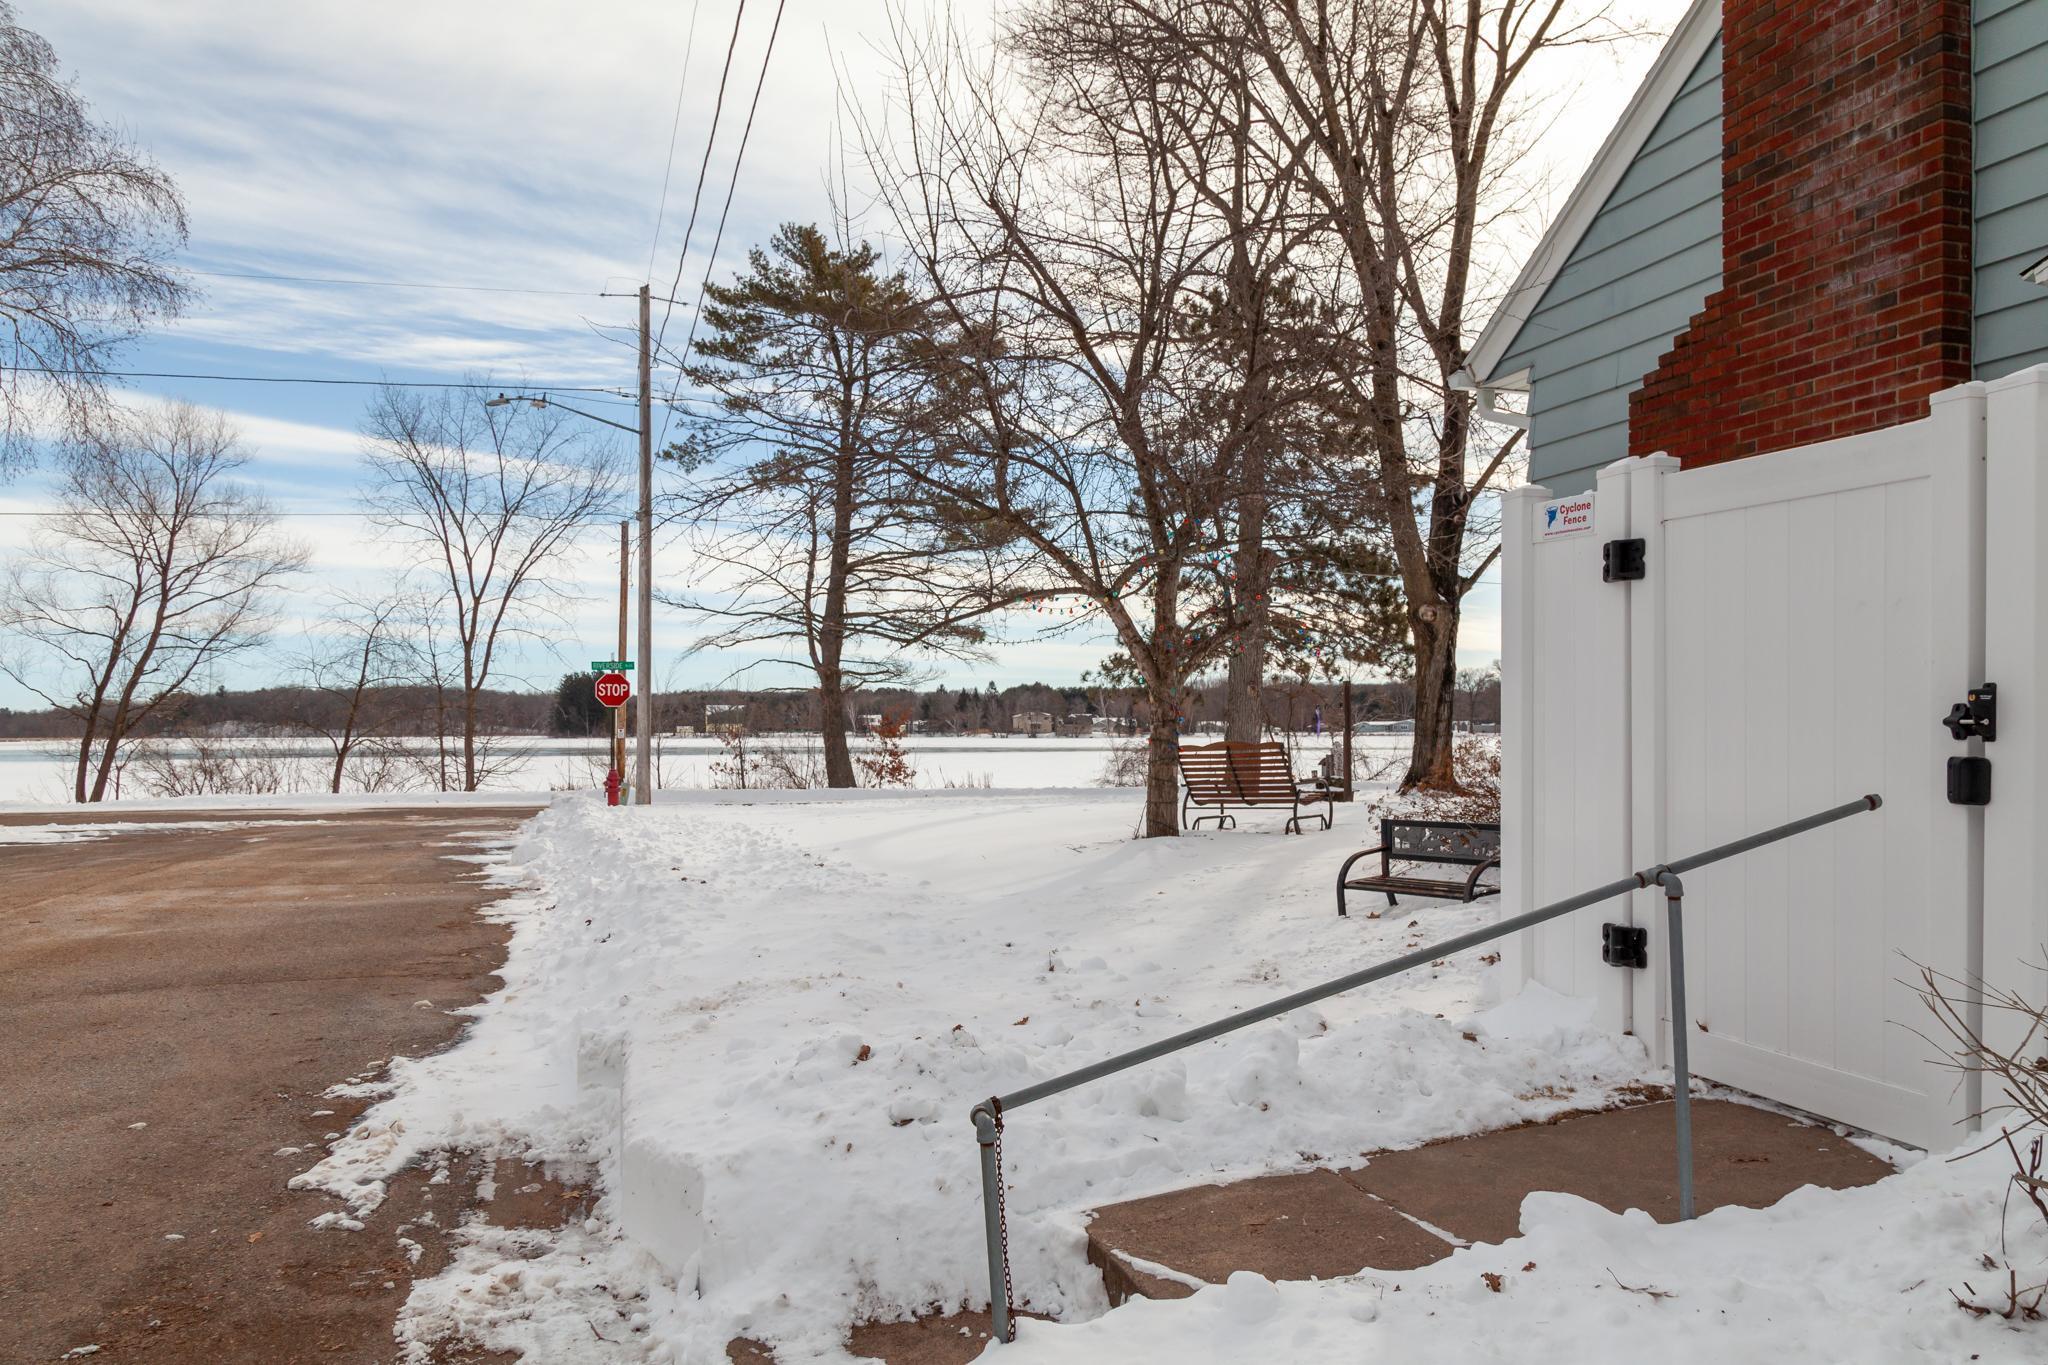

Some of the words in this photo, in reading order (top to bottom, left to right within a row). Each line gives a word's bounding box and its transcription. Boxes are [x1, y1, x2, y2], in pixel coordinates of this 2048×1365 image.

[1560, 502, 1591, 515] Cyclone
[1563, 515, 1587, 525] Fence
[598, 683, 628, 696] STOP
